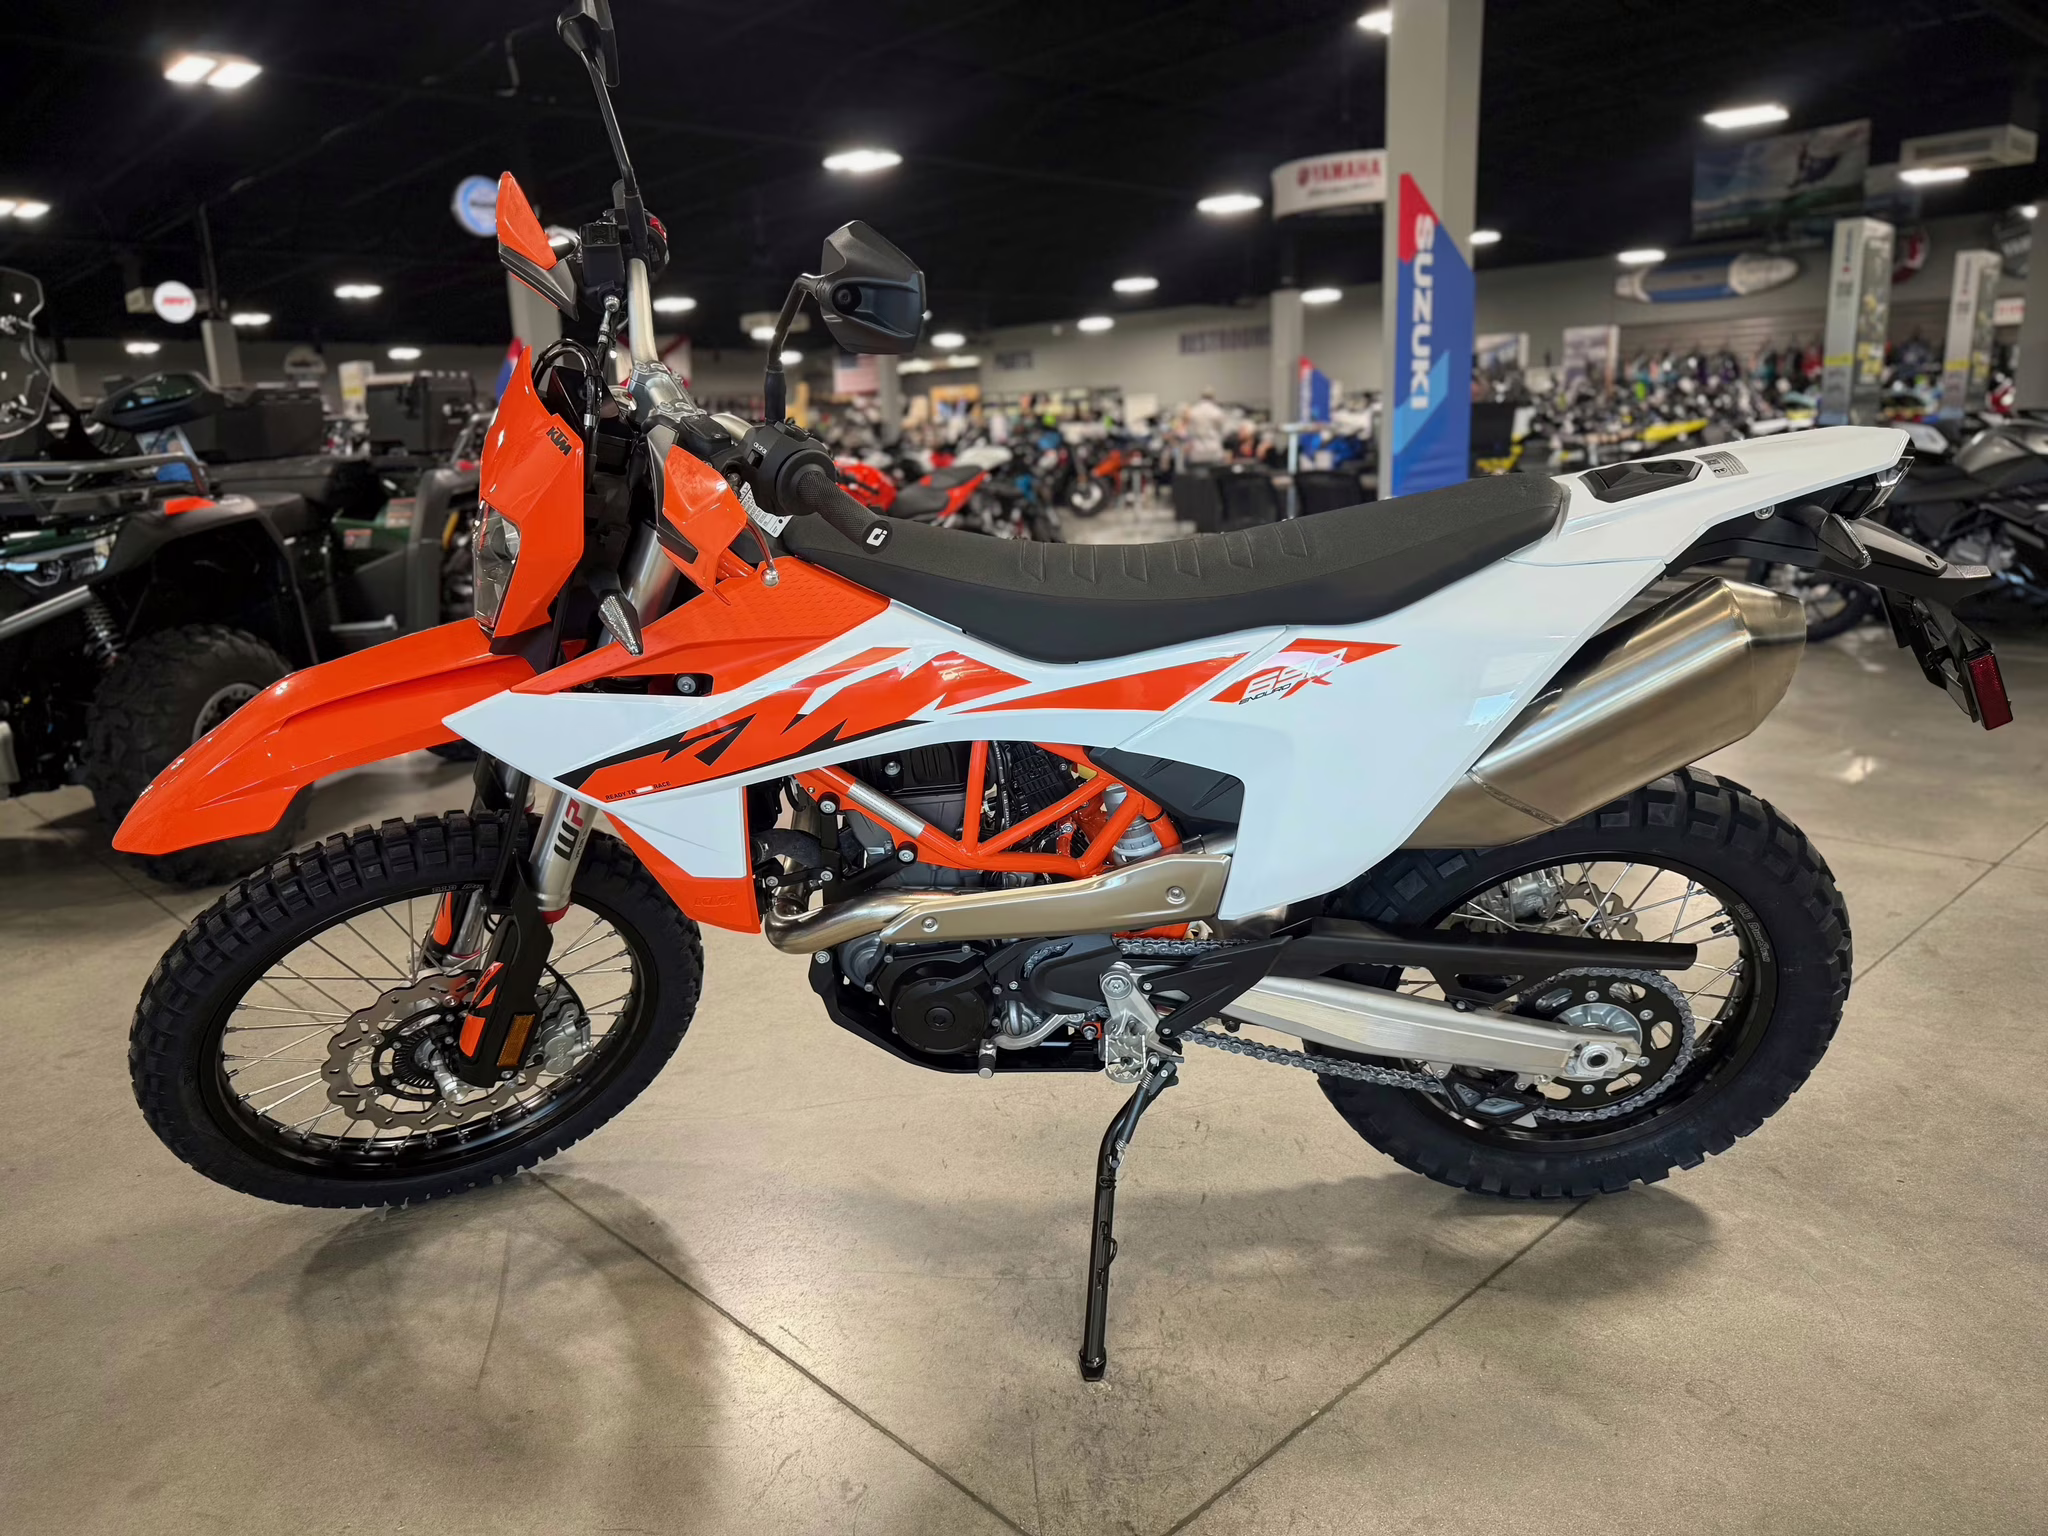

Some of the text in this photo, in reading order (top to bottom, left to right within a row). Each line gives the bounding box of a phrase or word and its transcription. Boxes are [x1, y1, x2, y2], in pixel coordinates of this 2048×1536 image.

[1410, 213, 1435, 410] SUZUKI
[545, 425, 573, 457] KTM
[1238, 682, 1292, 706] ENDURO
[605, 791, 627, 801] READY
[653, 780, 672, 790] RACE
